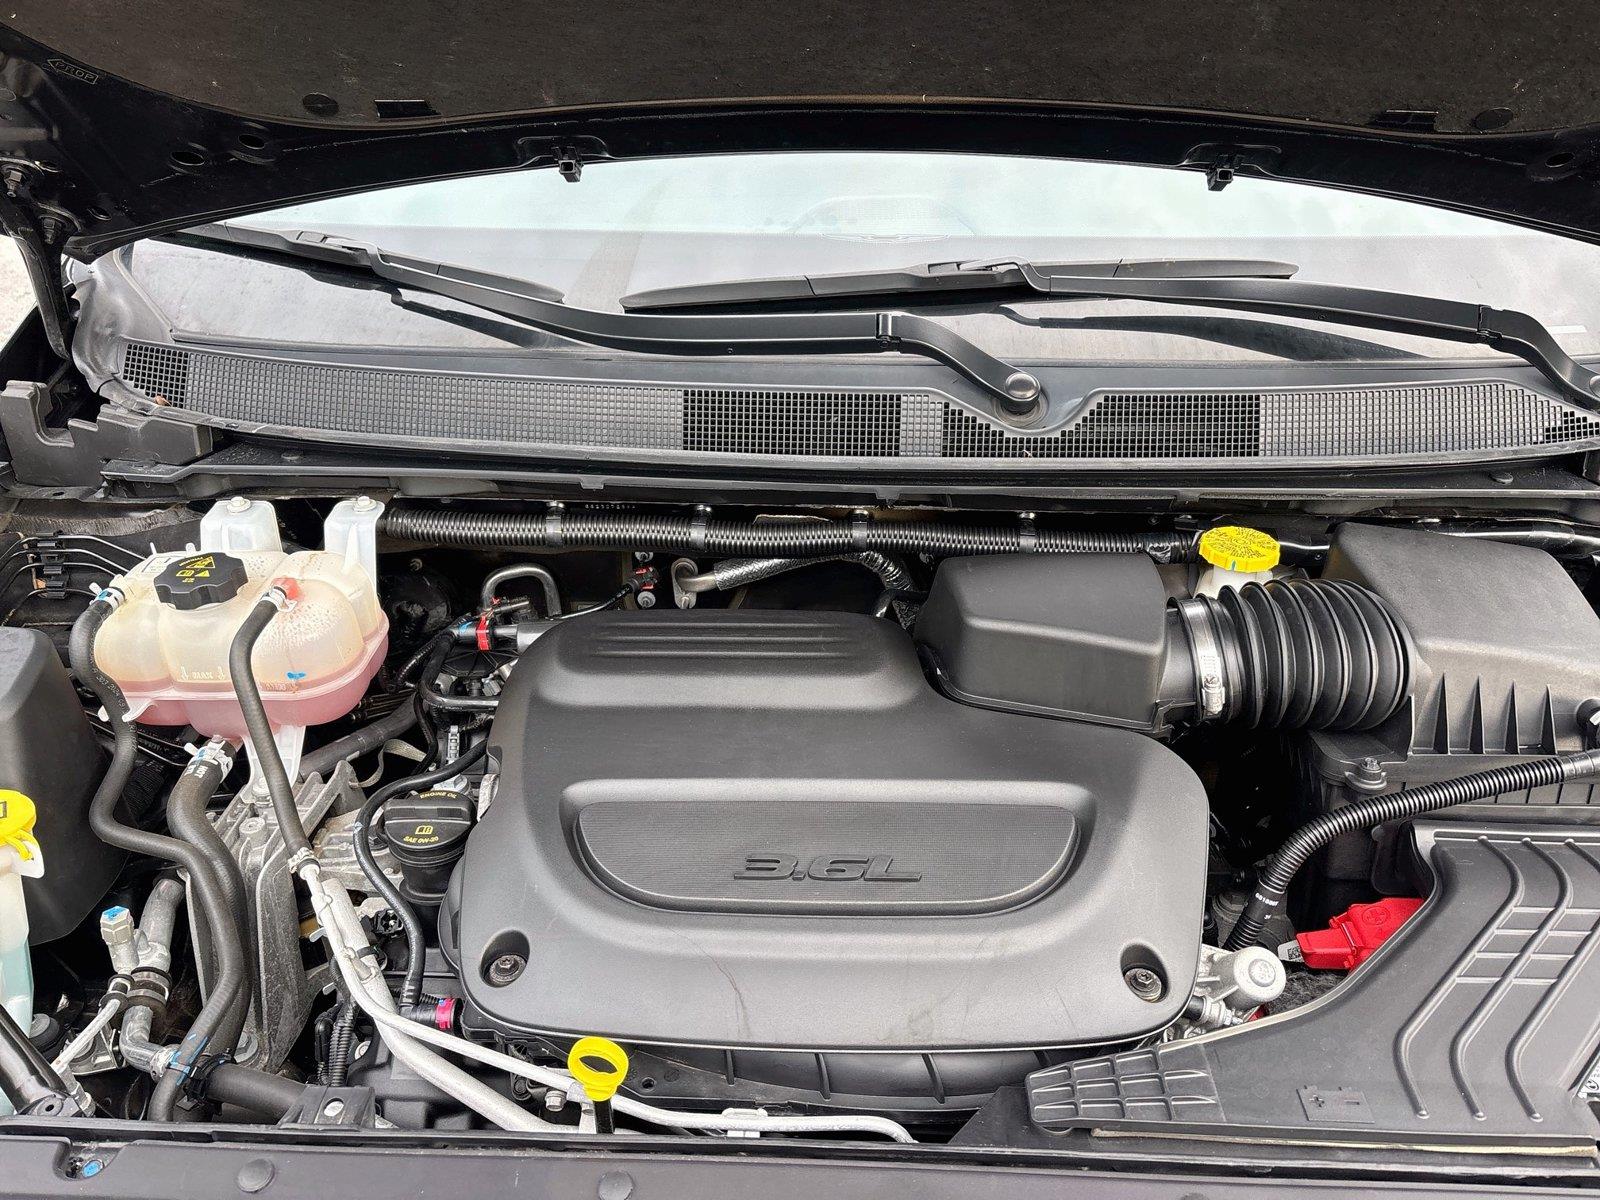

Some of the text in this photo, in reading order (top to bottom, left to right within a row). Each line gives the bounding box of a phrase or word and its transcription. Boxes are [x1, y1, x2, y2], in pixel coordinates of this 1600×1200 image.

[55, 61, 95, 80] PROP
[420, 791, 446, 799] ENGINE
[733, 853, 923, 882] 3.6L
